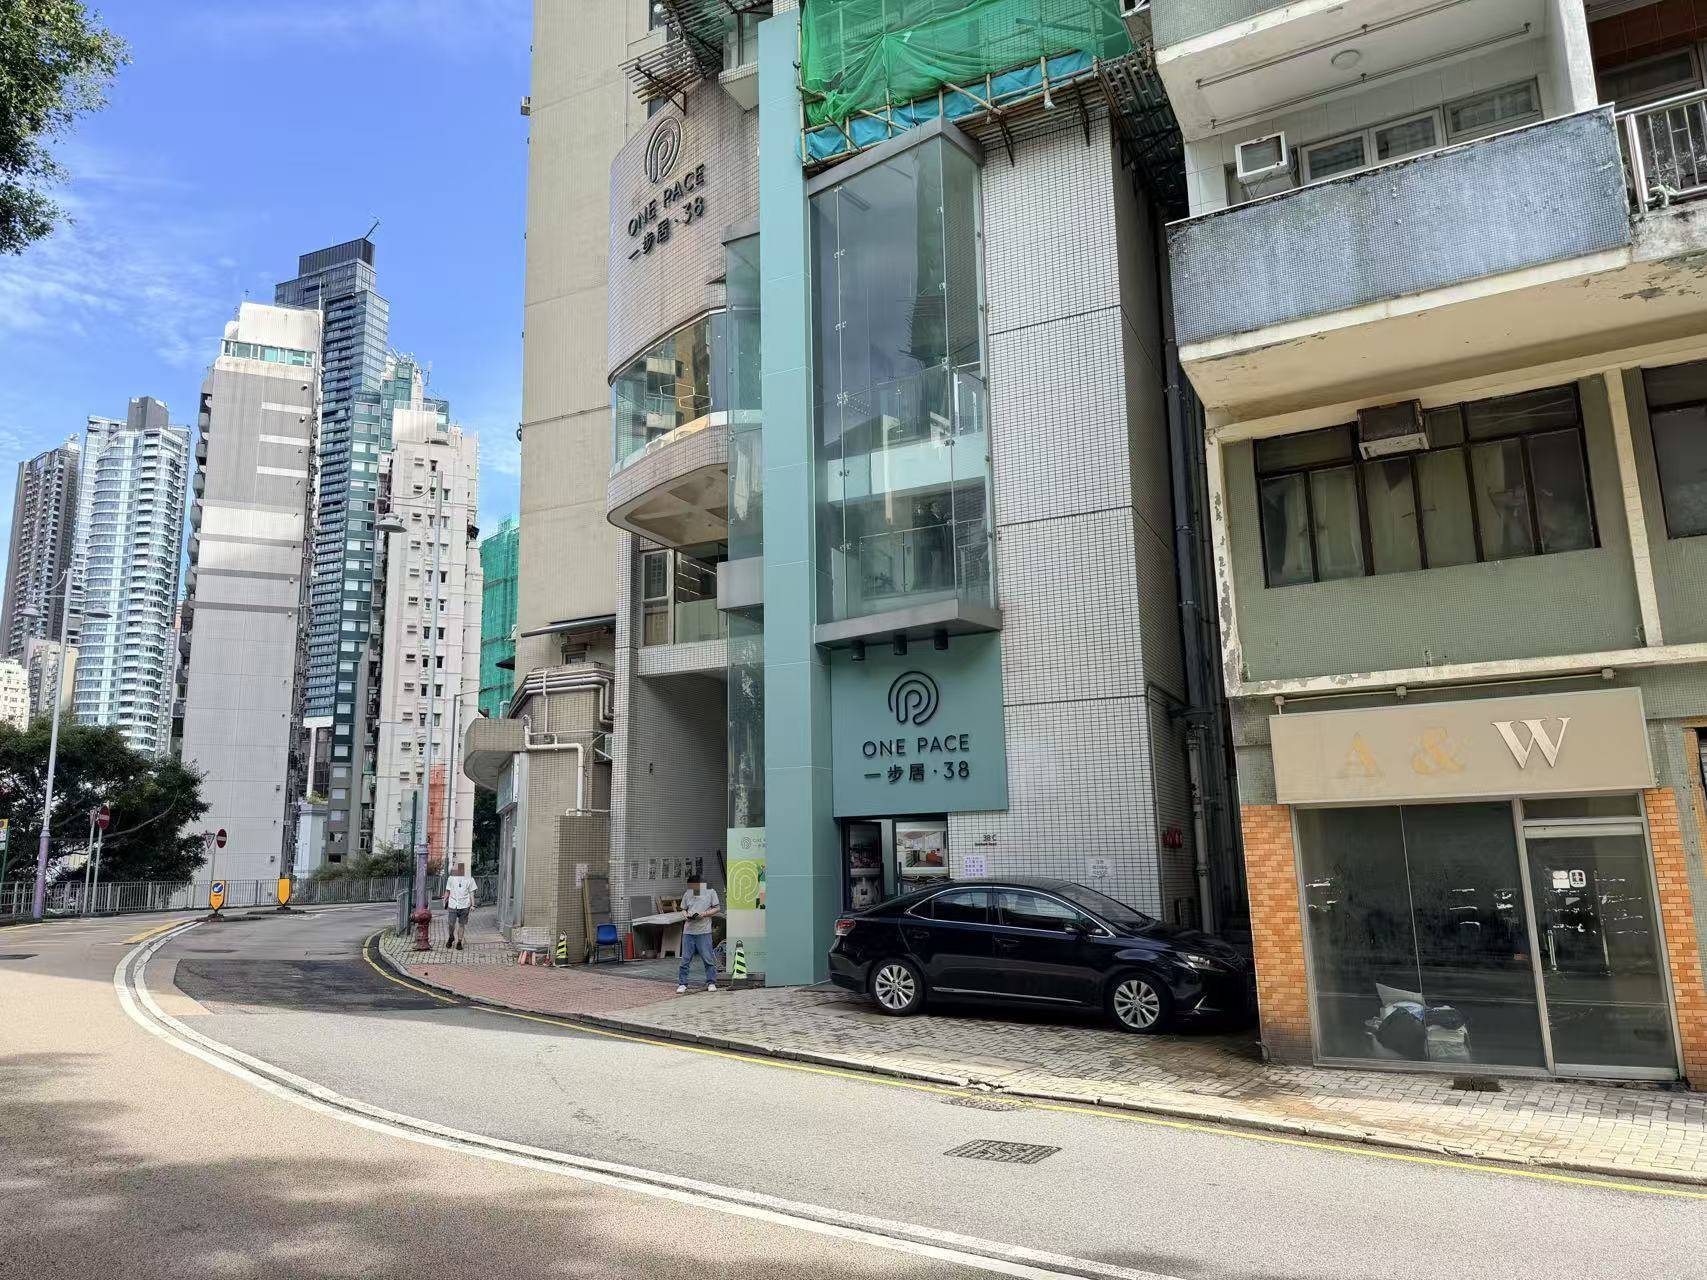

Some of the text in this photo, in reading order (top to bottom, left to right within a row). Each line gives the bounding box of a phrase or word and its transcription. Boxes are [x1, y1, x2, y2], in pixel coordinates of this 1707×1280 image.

[628, 164, 705, 237] ONE PACE
[862, 733, 970, 758] ONE PACE
[1491, 717, 1572, 769] W
